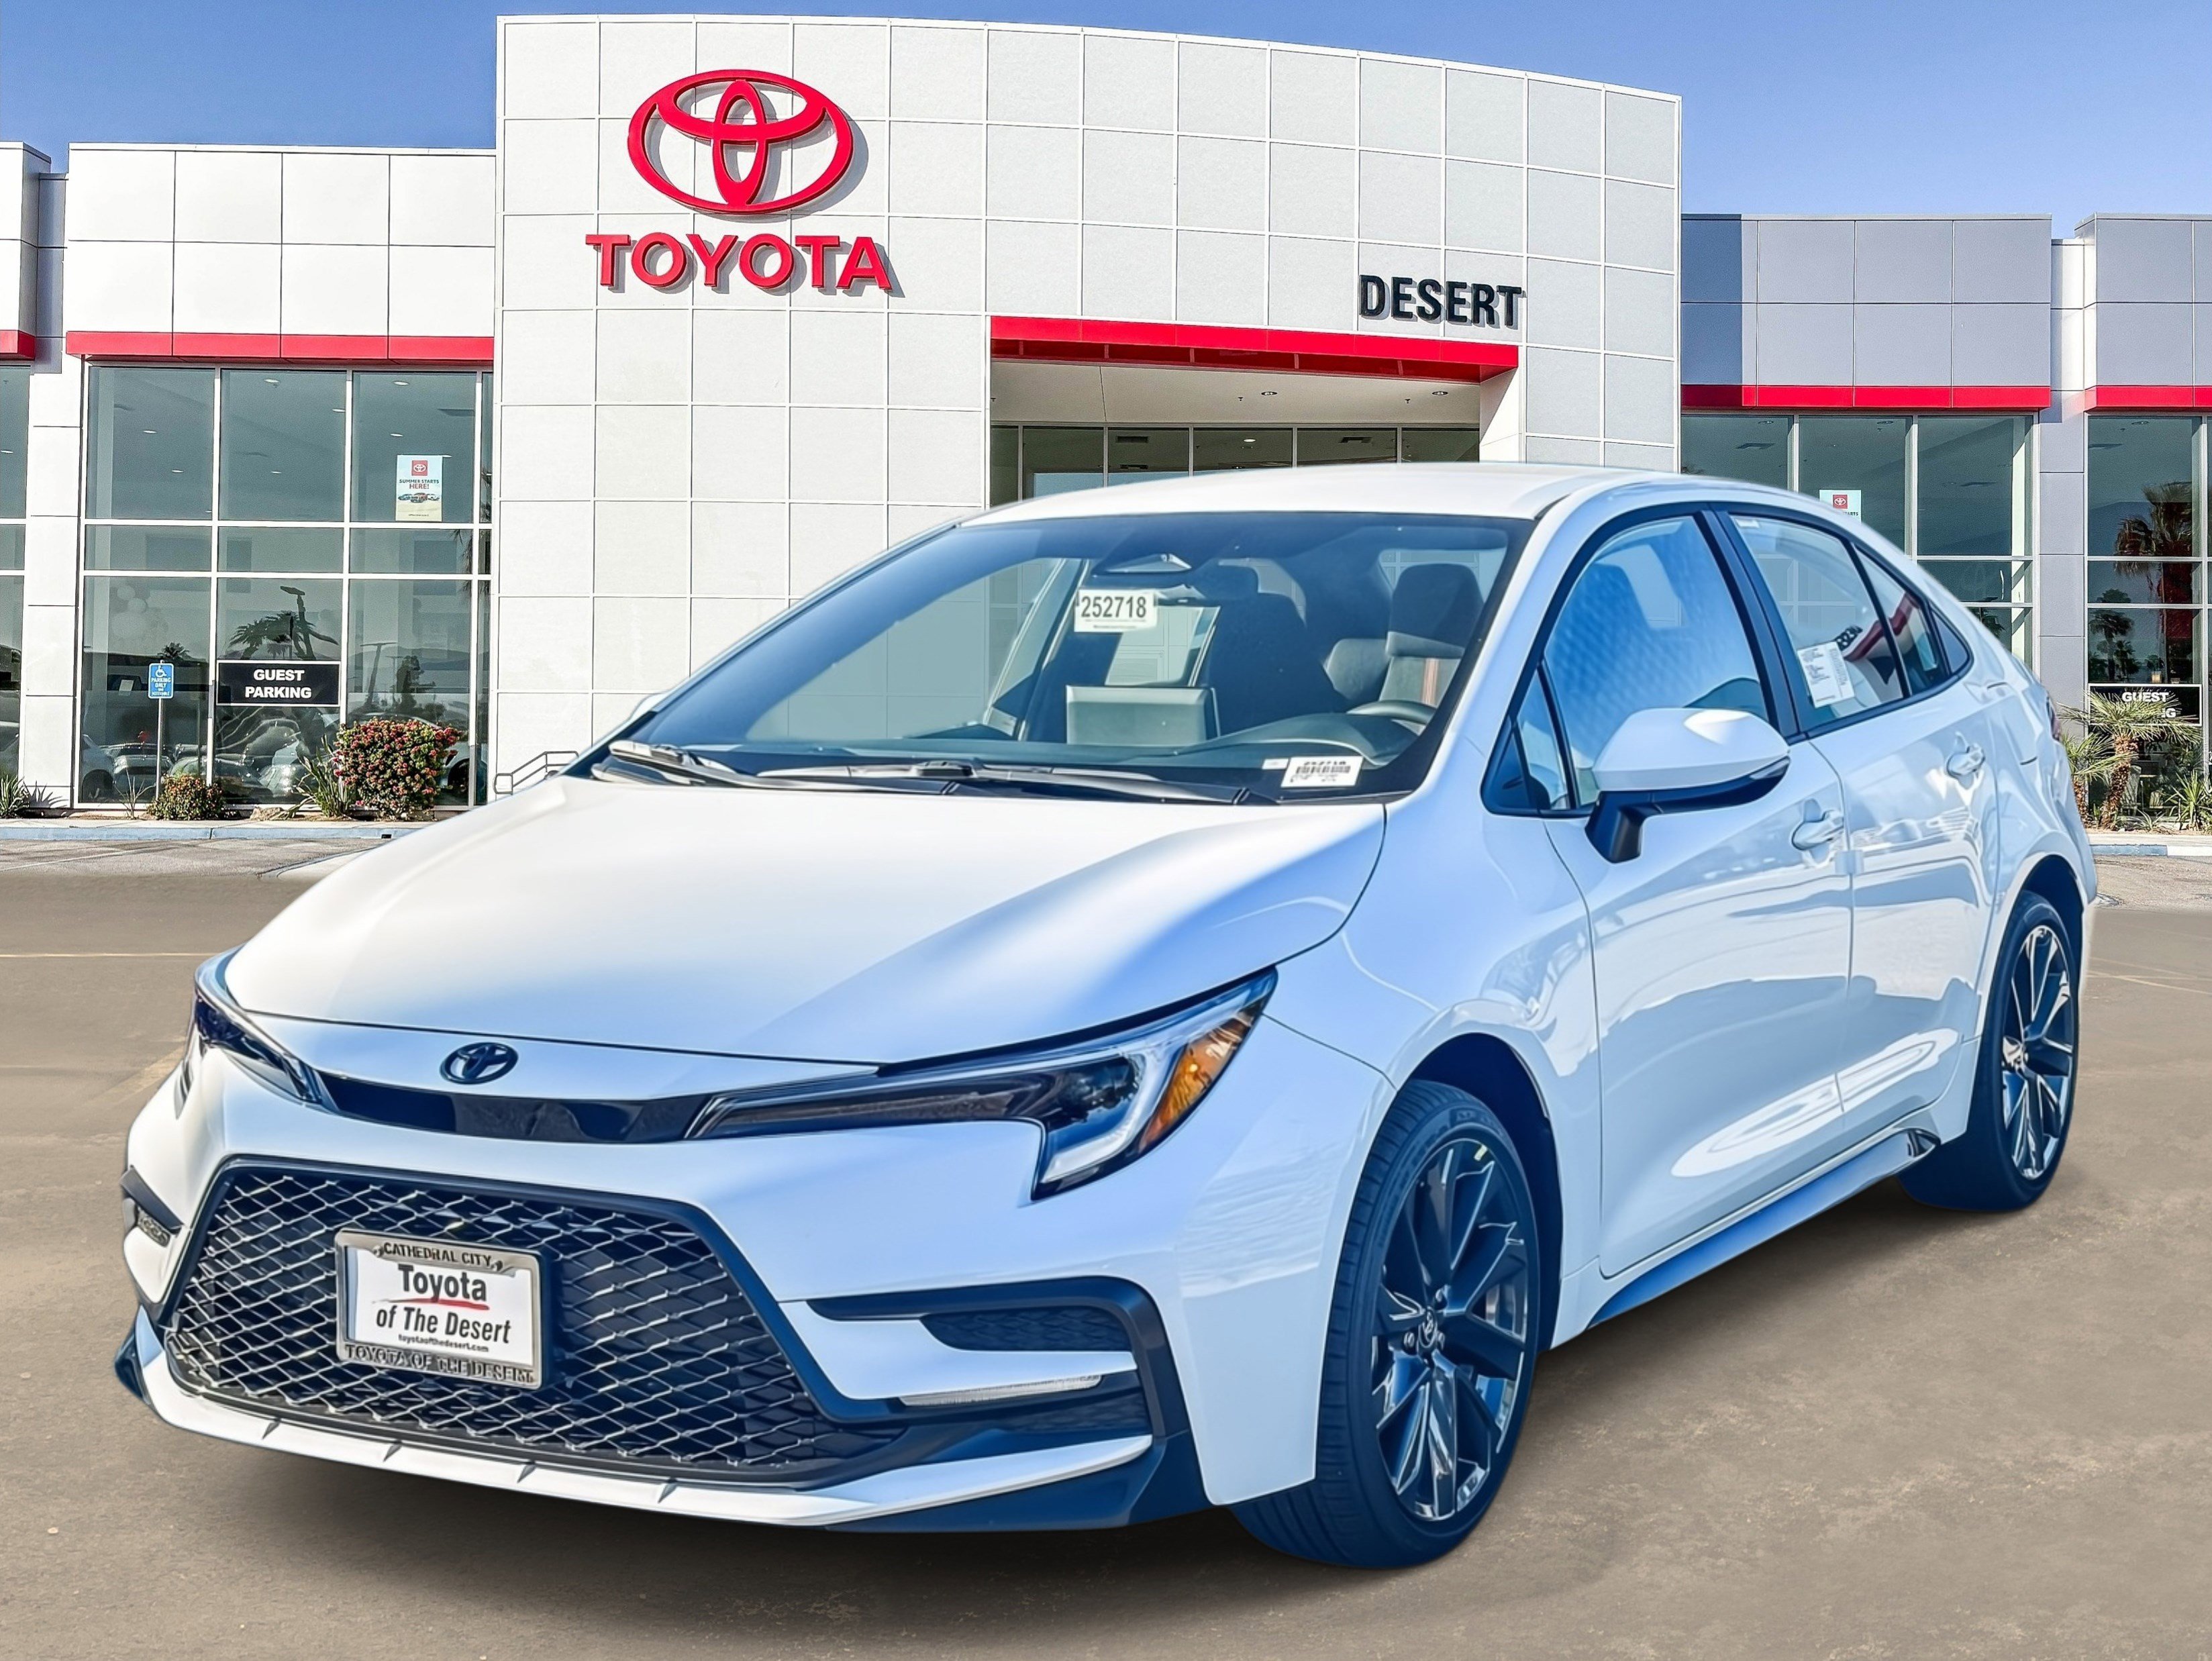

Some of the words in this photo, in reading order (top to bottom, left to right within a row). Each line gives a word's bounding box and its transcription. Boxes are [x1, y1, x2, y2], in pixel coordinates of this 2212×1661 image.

[585, 232, 893, 289] TOYOTA
[1359, 274, 1522, 327] DESERT
[1081, 596, 1146, 617] 252718
[253, 668, 305, 681] GUEST
[244, 686, 312, 699] PARKING
[383, 1242, 458, 1262] CATHEDRAL
[462, 1252, 492, 1266] CITY
[398, 1264, 487, 1302] Toyota
[376, 1306, 398, 1328] of
[403, 1307, 439, 1333] The
[445, 1312, 511, 1344] Desert
